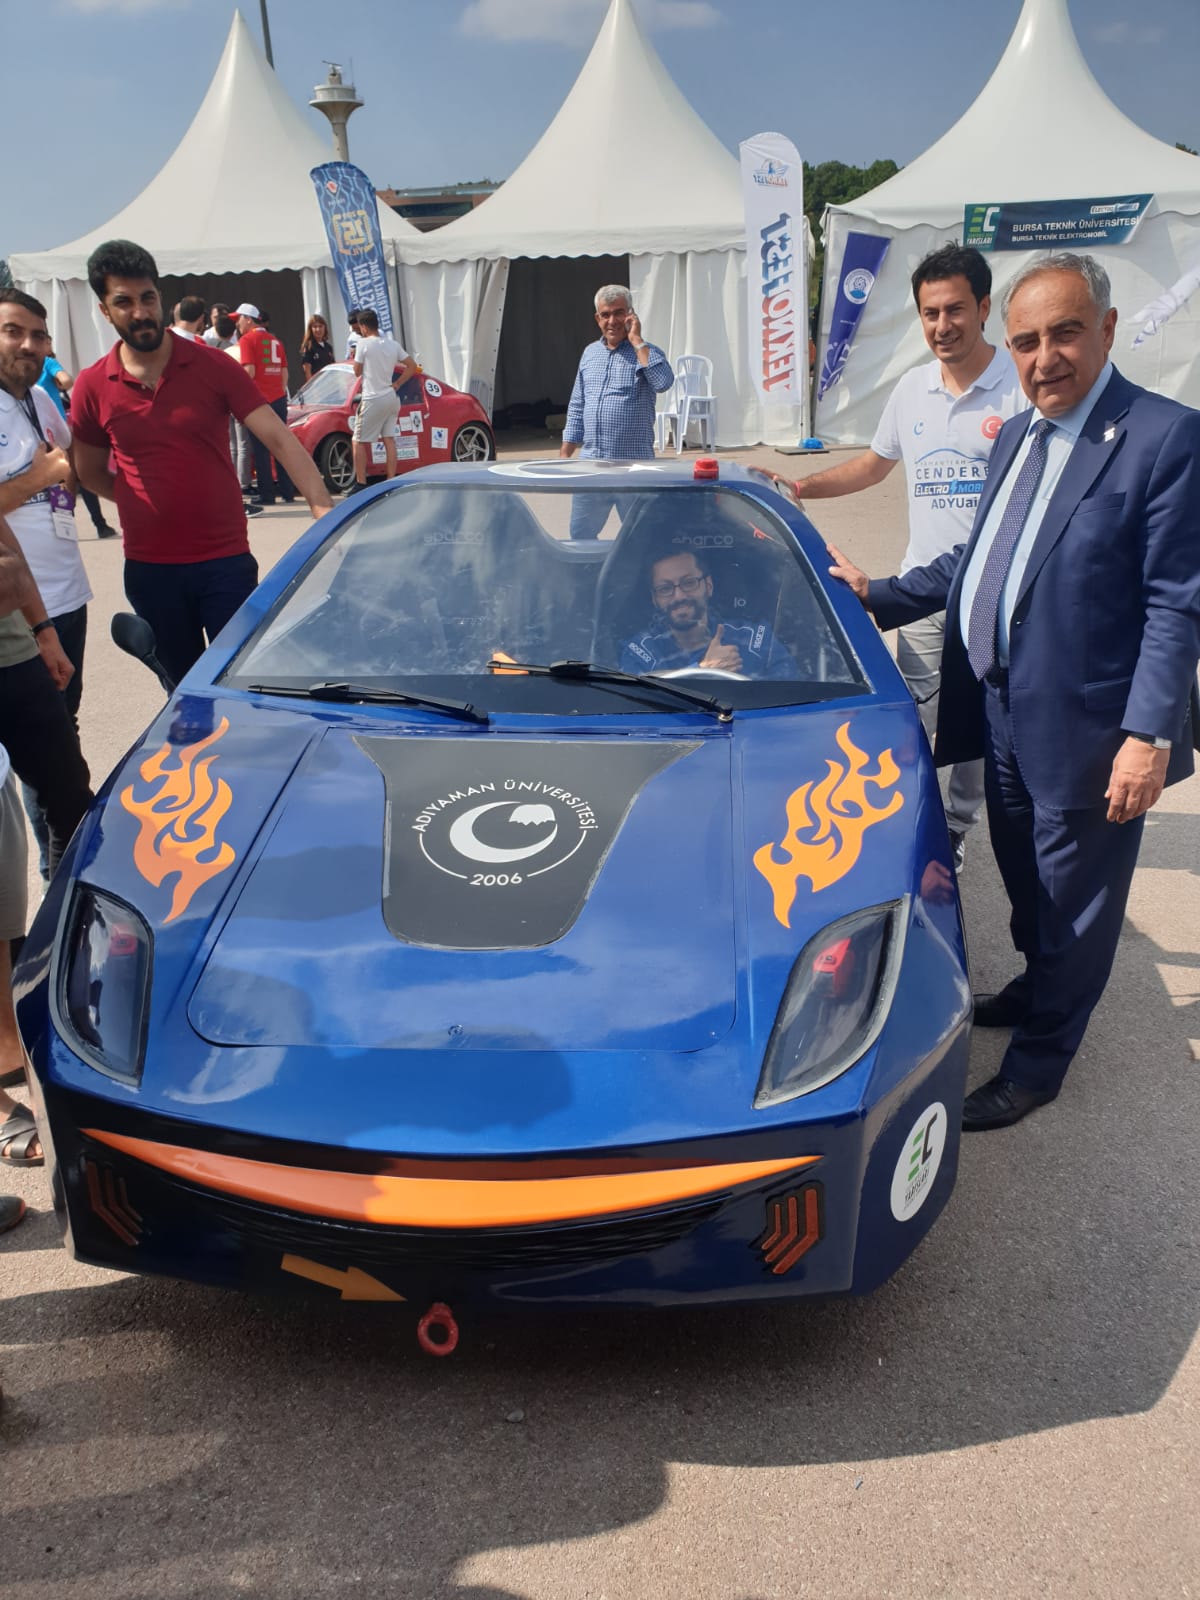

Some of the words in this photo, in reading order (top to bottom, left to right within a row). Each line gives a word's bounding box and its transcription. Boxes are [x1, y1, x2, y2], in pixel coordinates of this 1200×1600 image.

[1012, 223, 1043, 233] BURSA
[1046, 219, 1077, 231] TEKNİK
[1079, 215, 1140, 229] ÜNİVERSİTESİ
[1012, 234, 1034, 242] BURSA
[1035, 232, 1057, 241] TEKNİK
[427, 382, 440, 393] 39
[915, 483, 950, 496] ELECTRO
[412, 783, 495, 832] ADIYAMAN
[504, 779, 599, 830] ÜNİVERSİTESİ
[469, 873, 523, 887] 2006
